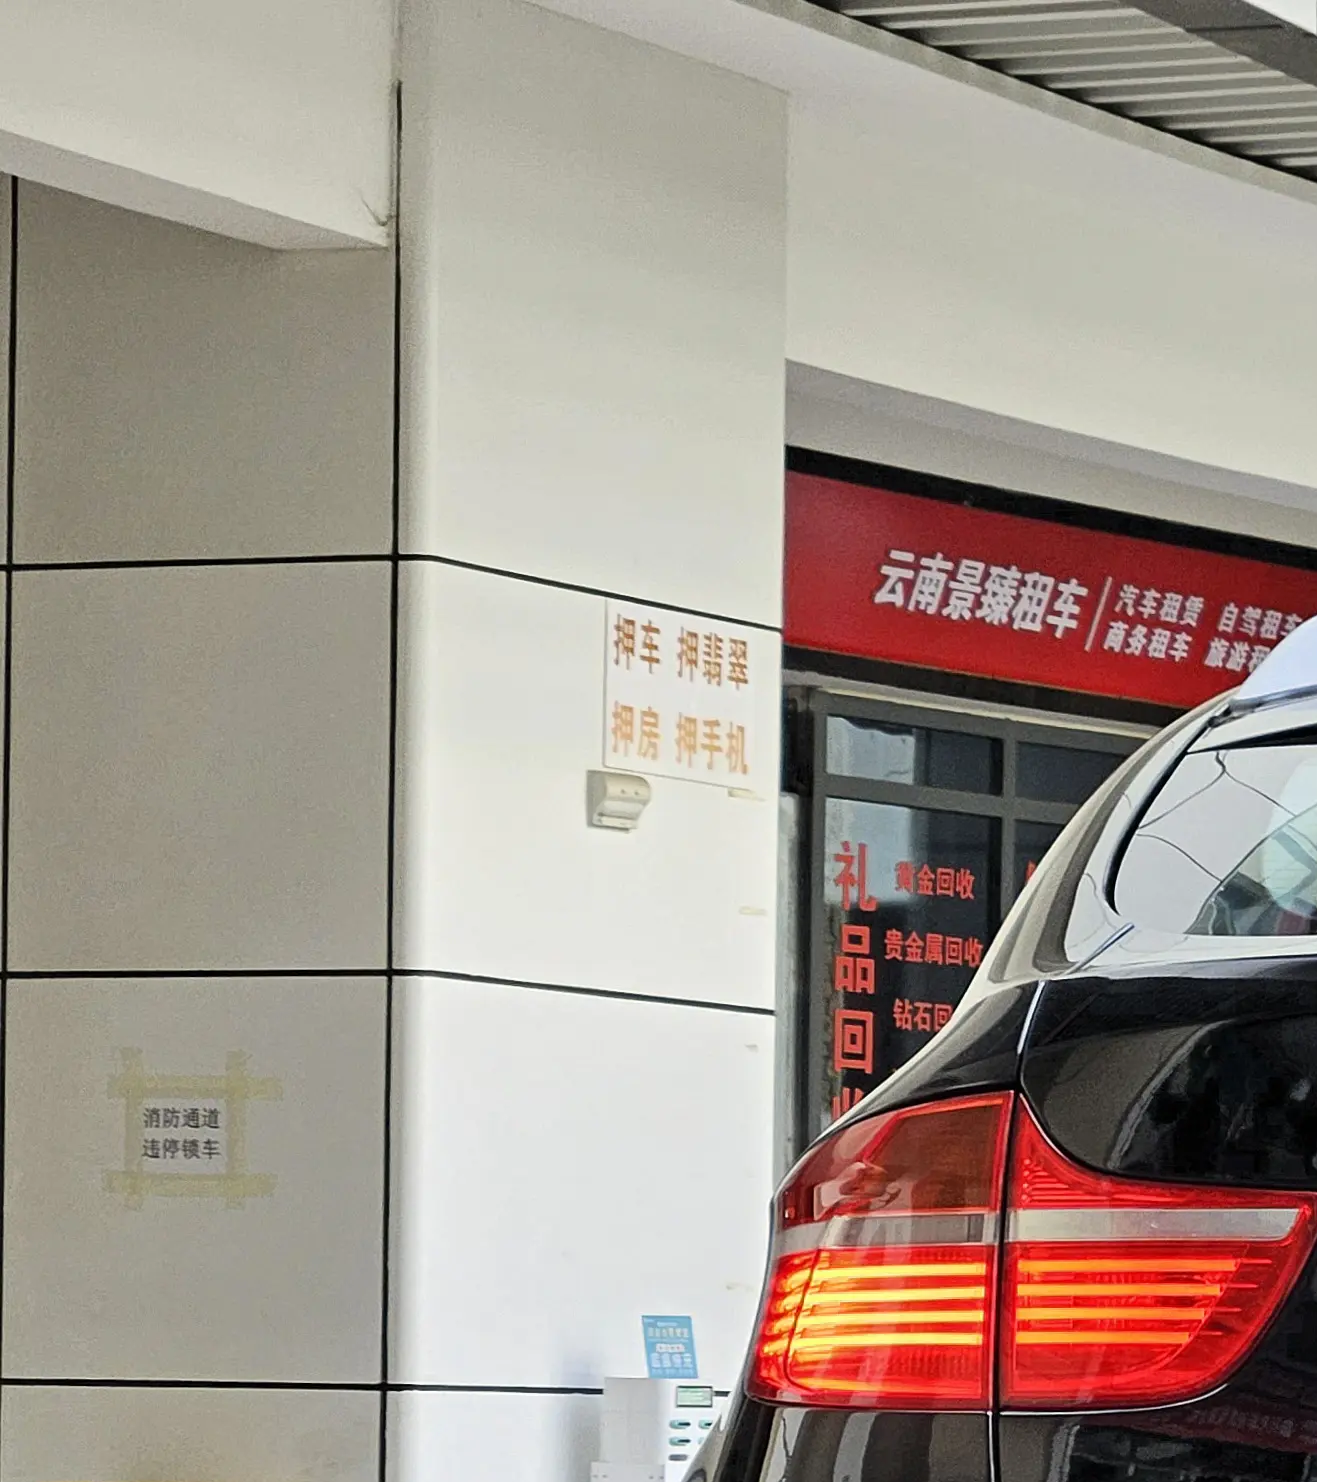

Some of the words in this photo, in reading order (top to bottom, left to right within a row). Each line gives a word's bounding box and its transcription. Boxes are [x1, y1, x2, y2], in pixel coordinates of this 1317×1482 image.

[874, 550, 1089, 638] 云南景臻租车
[1114, 583, 1205, 628] 汽车租赁
[613, 613, 661, 675] 押车
[677, 626, 749, 691] 押翡翠
[1103, 620, 1193, 662] 商务租车
[612, 700, 661, 761] 押房
[675, 712, 748, 776] 押手机
[894, 861, 976, 900] 黄金回收
[884, 928, 985, 968] 贵金属回收
[143, 1107, 221, 1129] 消防通道
[142, 1138, 221, 1160] 违停锁车
